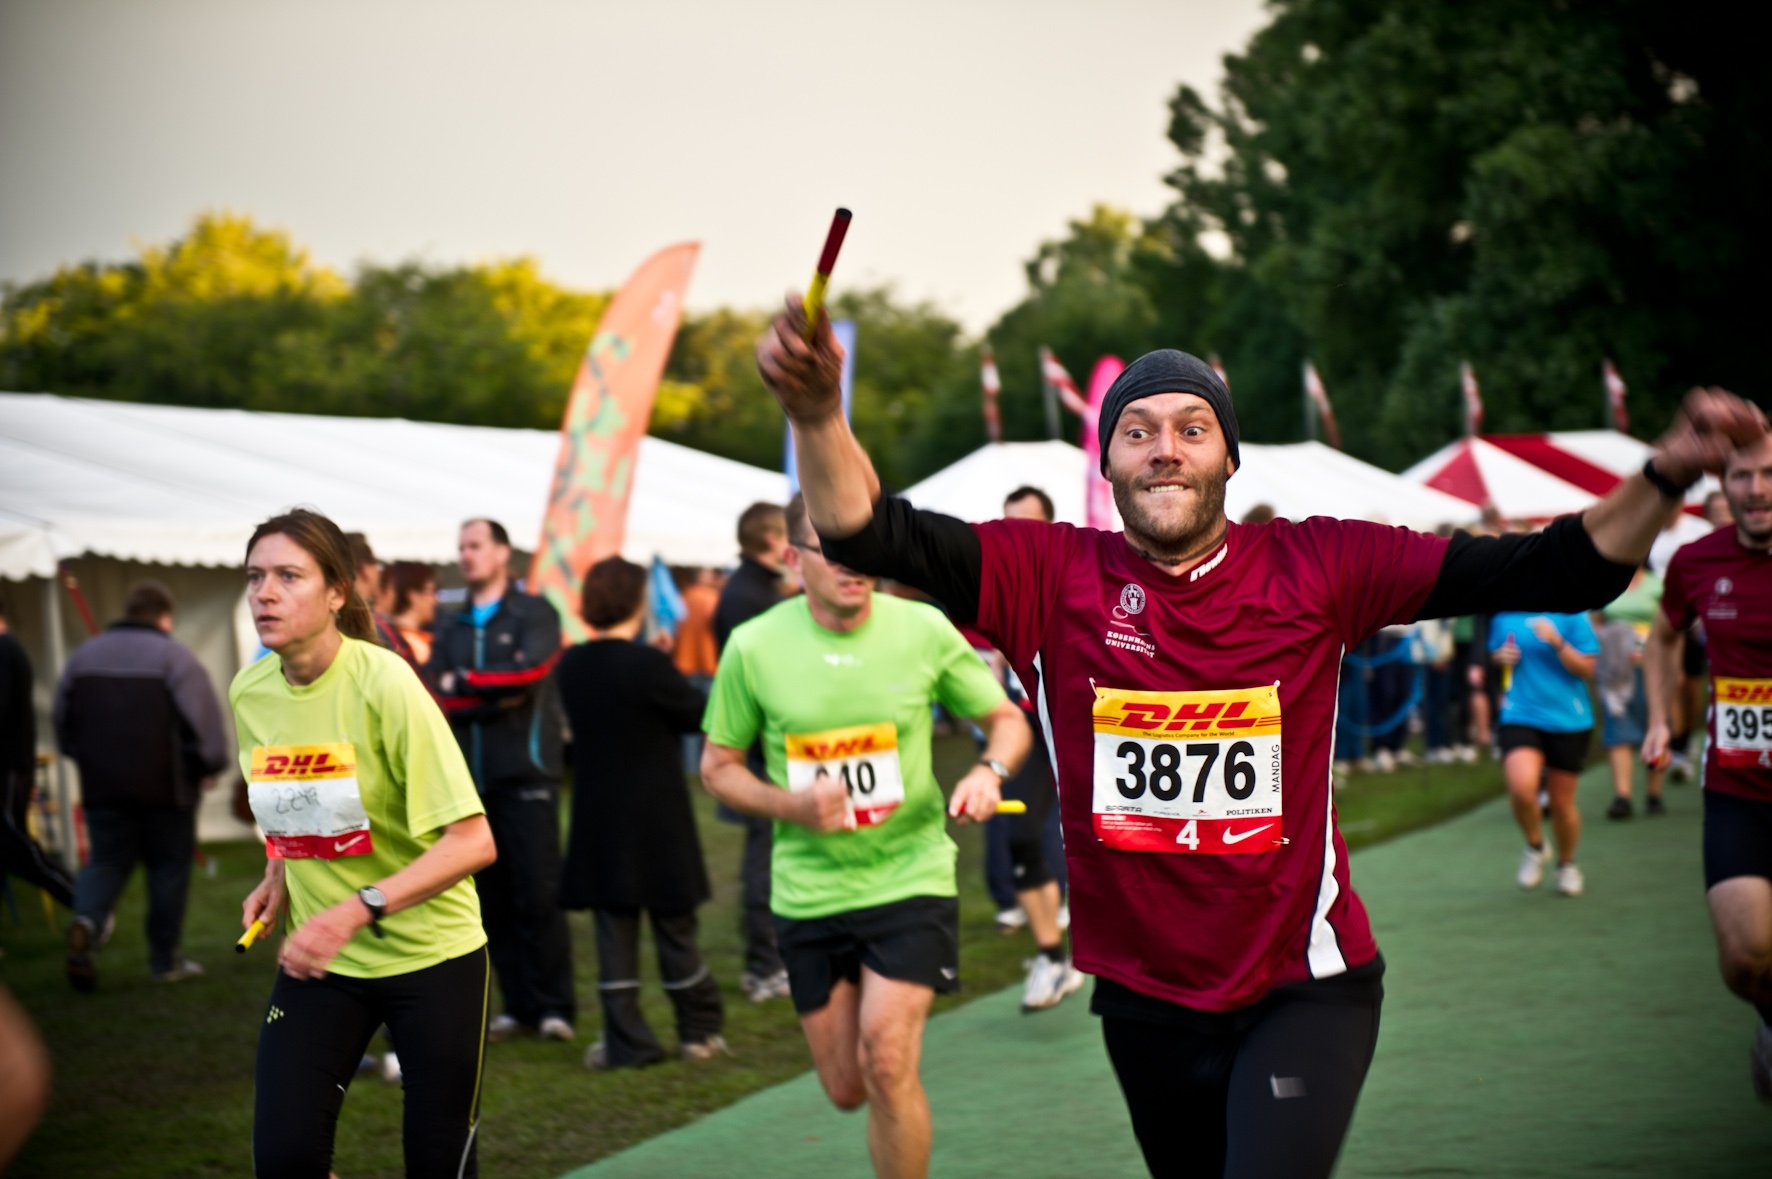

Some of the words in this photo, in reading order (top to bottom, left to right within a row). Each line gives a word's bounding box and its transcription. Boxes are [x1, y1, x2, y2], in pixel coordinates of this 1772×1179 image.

[1119, 701, 1258, 731] DHL
[263, 753, 337, 775] DHL
[1116, 741, 1257, 803] 3876
[1271, 744, 1280, 793] MANDAG
[1226, 807, 1273, 816] POLITIKEN
[1175, 819, 1200, 851] 4
